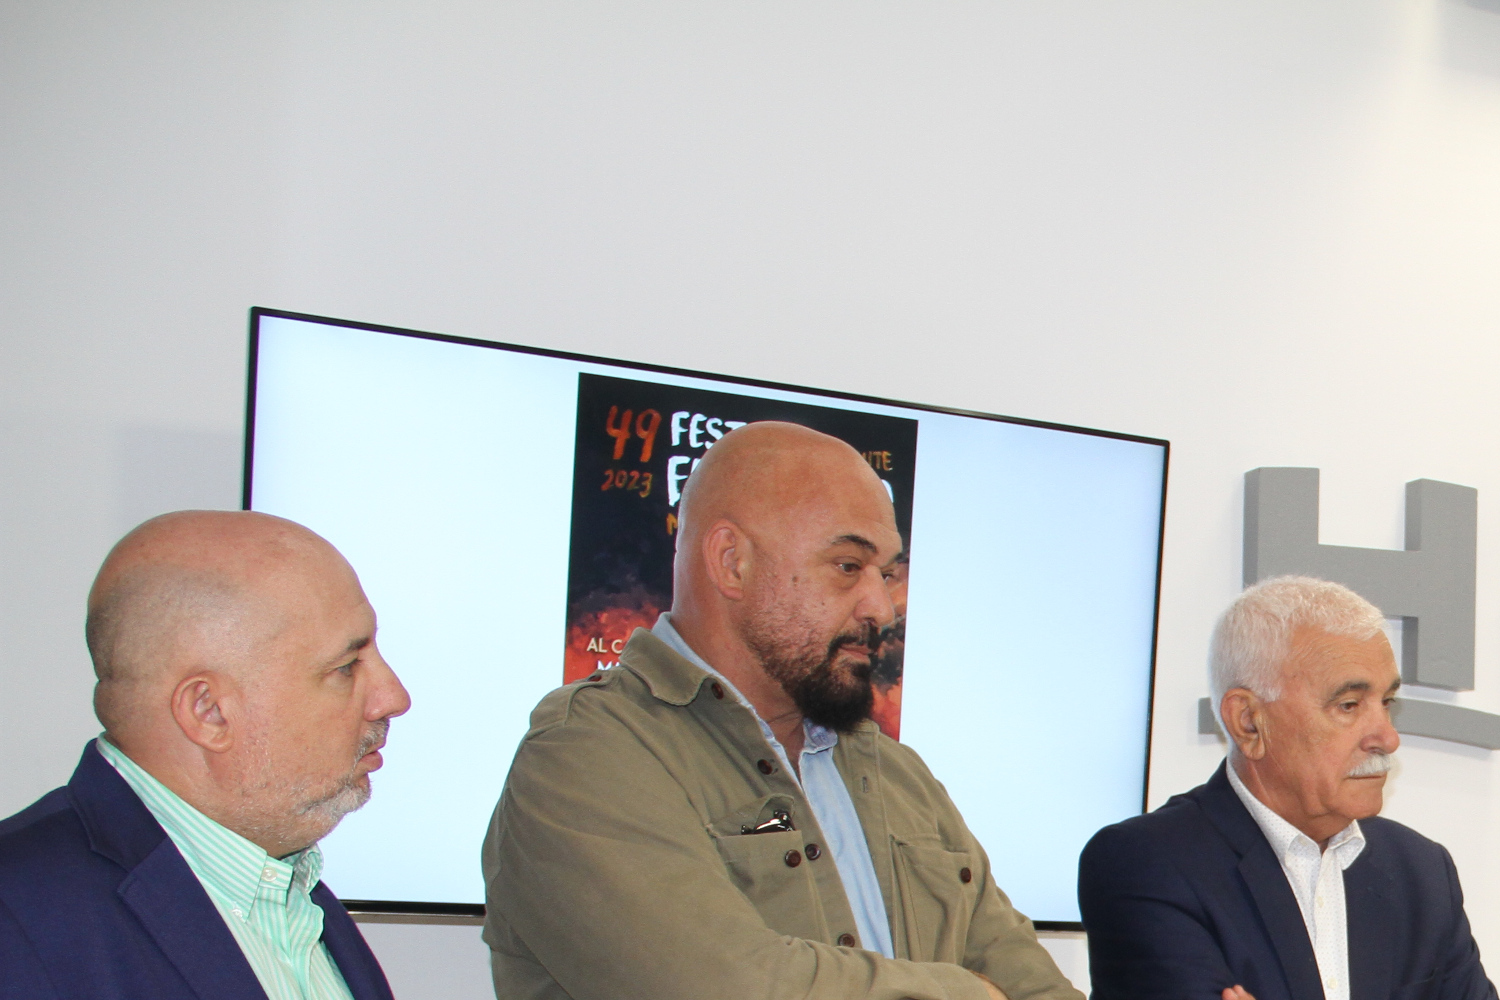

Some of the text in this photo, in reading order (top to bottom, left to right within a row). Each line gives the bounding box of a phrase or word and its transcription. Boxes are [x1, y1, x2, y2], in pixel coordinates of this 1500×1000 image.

[606, 405, 661, 462] 49
[601, 469, 652, 498] 2023
[586, 637, 608, 653] AL
